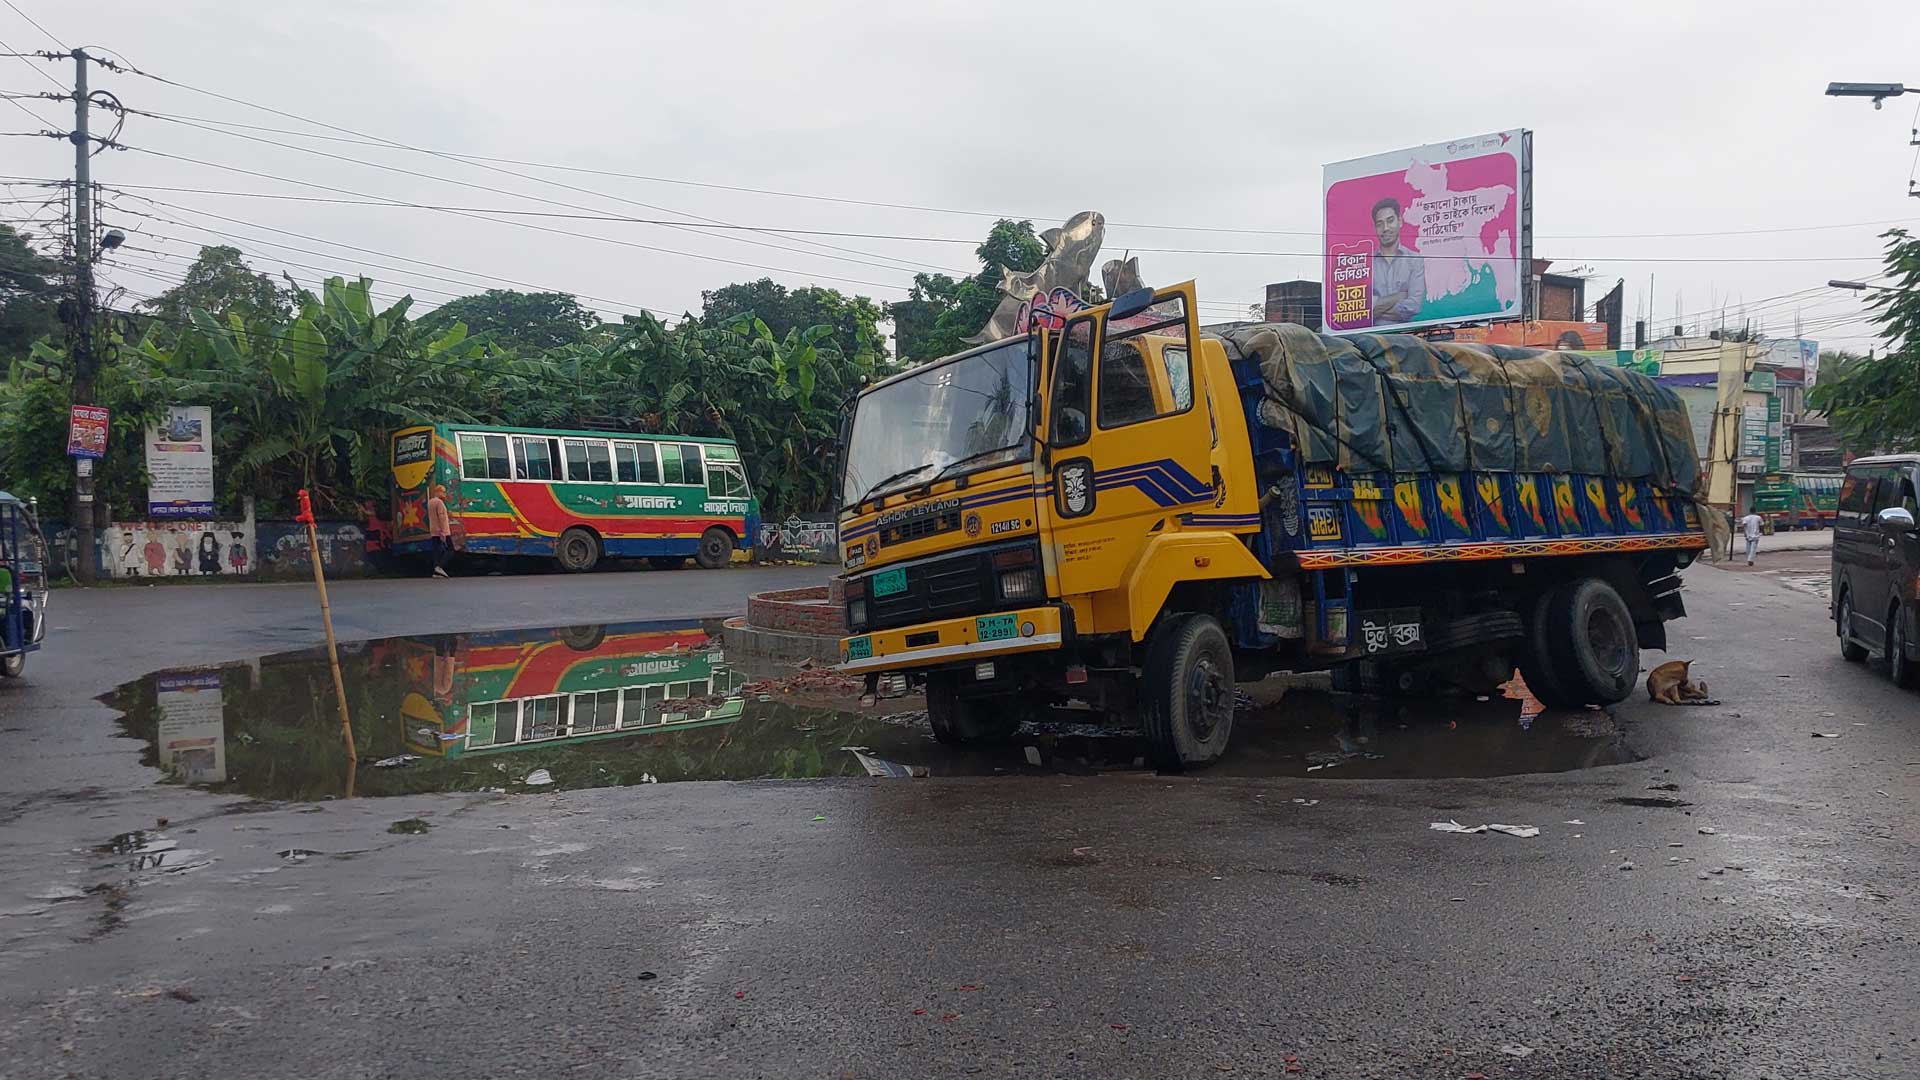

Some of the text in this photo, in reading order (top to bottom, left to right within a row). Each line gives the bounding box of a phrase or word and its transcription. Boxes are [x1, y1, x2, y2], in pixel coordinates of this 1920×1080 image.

[1453, 195, 1477, 206] টাকায়
[1422, 204, 1495, 223] ছোট ভাইকে বিদেশ
[1337, 253, 1368, 266] বিকাশ
[1334, 267, 1370, 281] ডিপিএস
[1336, 285, 1367, 300] টাকা
[1332, 309, 1370, 322] সারাদেশ
[623, 496, 676, 508] আনন্দ
[704, 502, 728, 514] মায়ের
[876, 498, 959, 526] ASHOK LEYLAND
[1361, 619, 1420, 652] টুল বক্স
